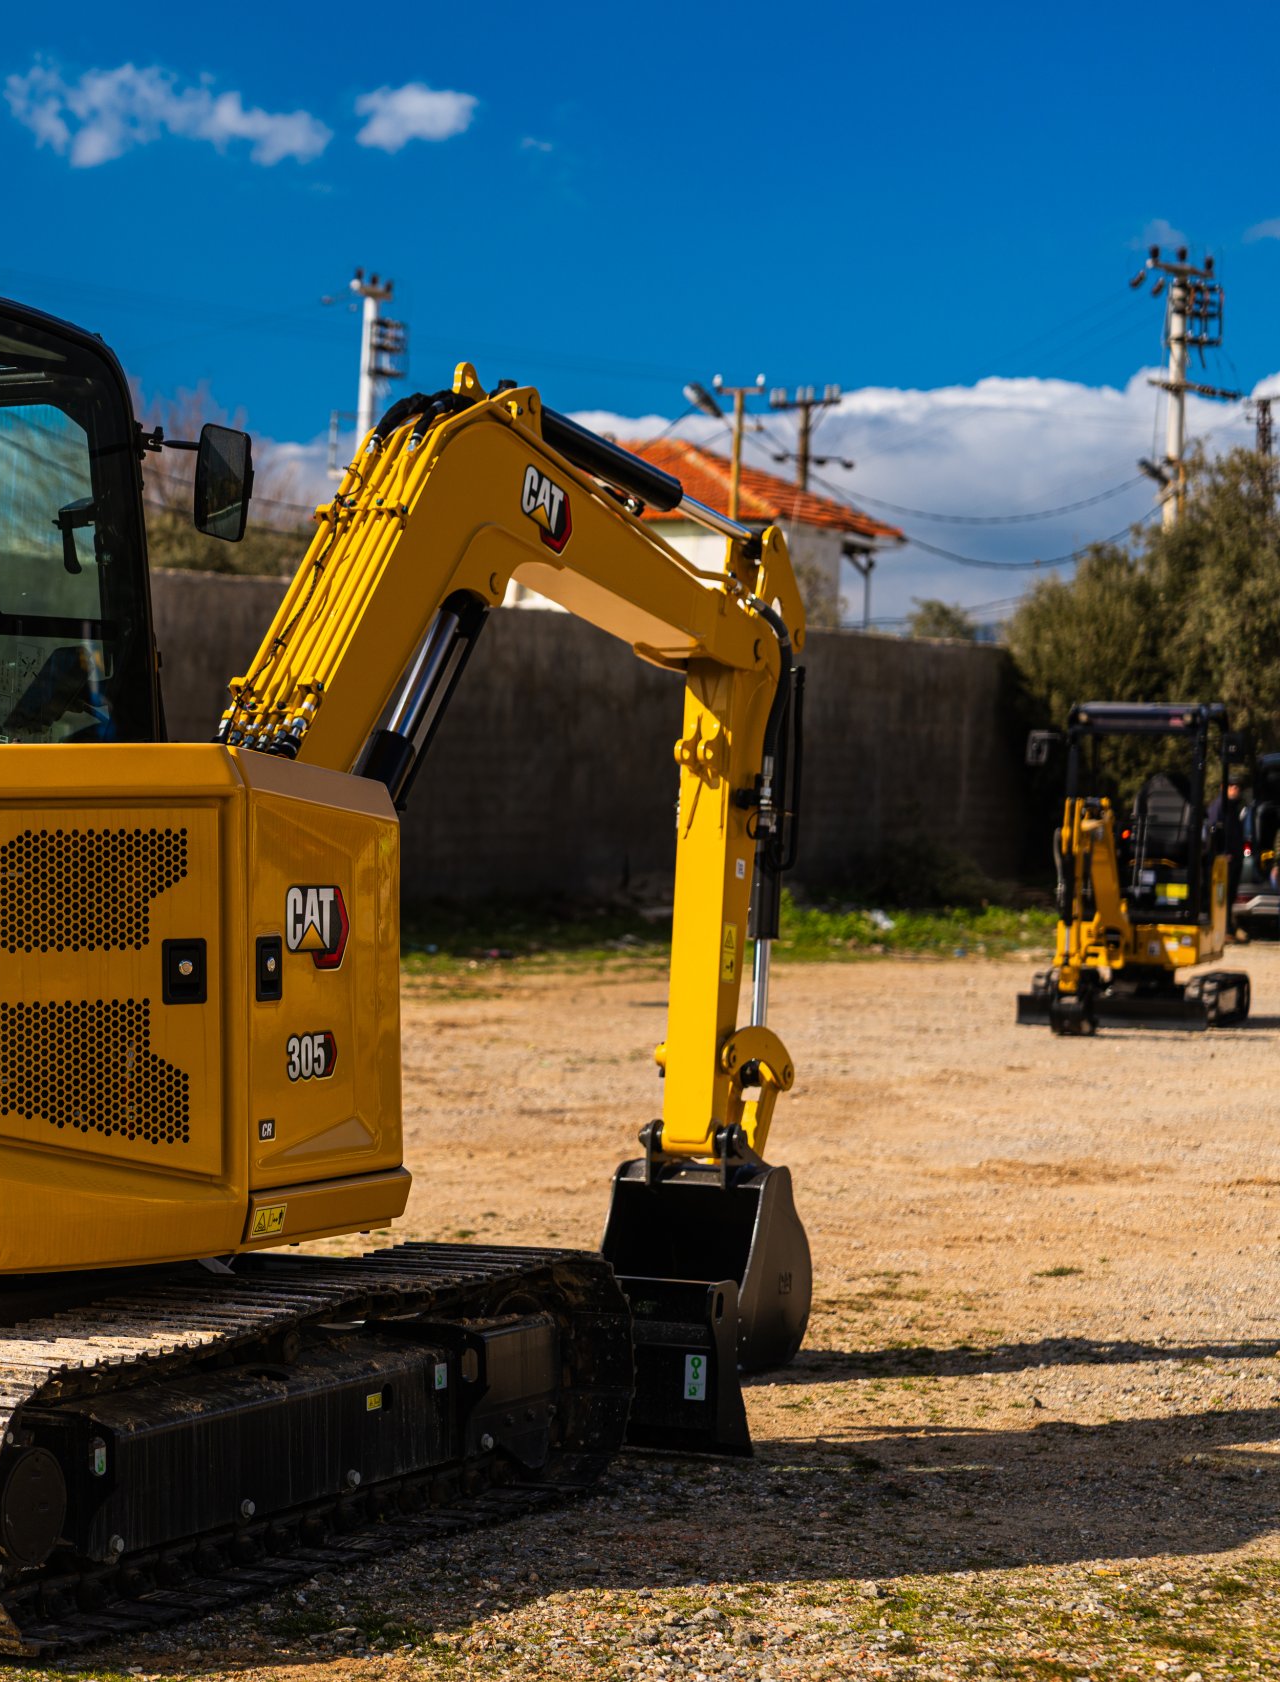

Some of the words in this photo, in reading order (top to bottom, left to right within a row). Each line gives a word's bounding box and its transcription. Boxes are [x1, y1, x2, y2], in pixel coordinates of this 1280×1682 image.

[522, 465, 564, 534] CAT
[286, 887, 334, 951] CAT
[287, 1033, 325, 1080] 305
[261, 1123, 273, 1136] CR
